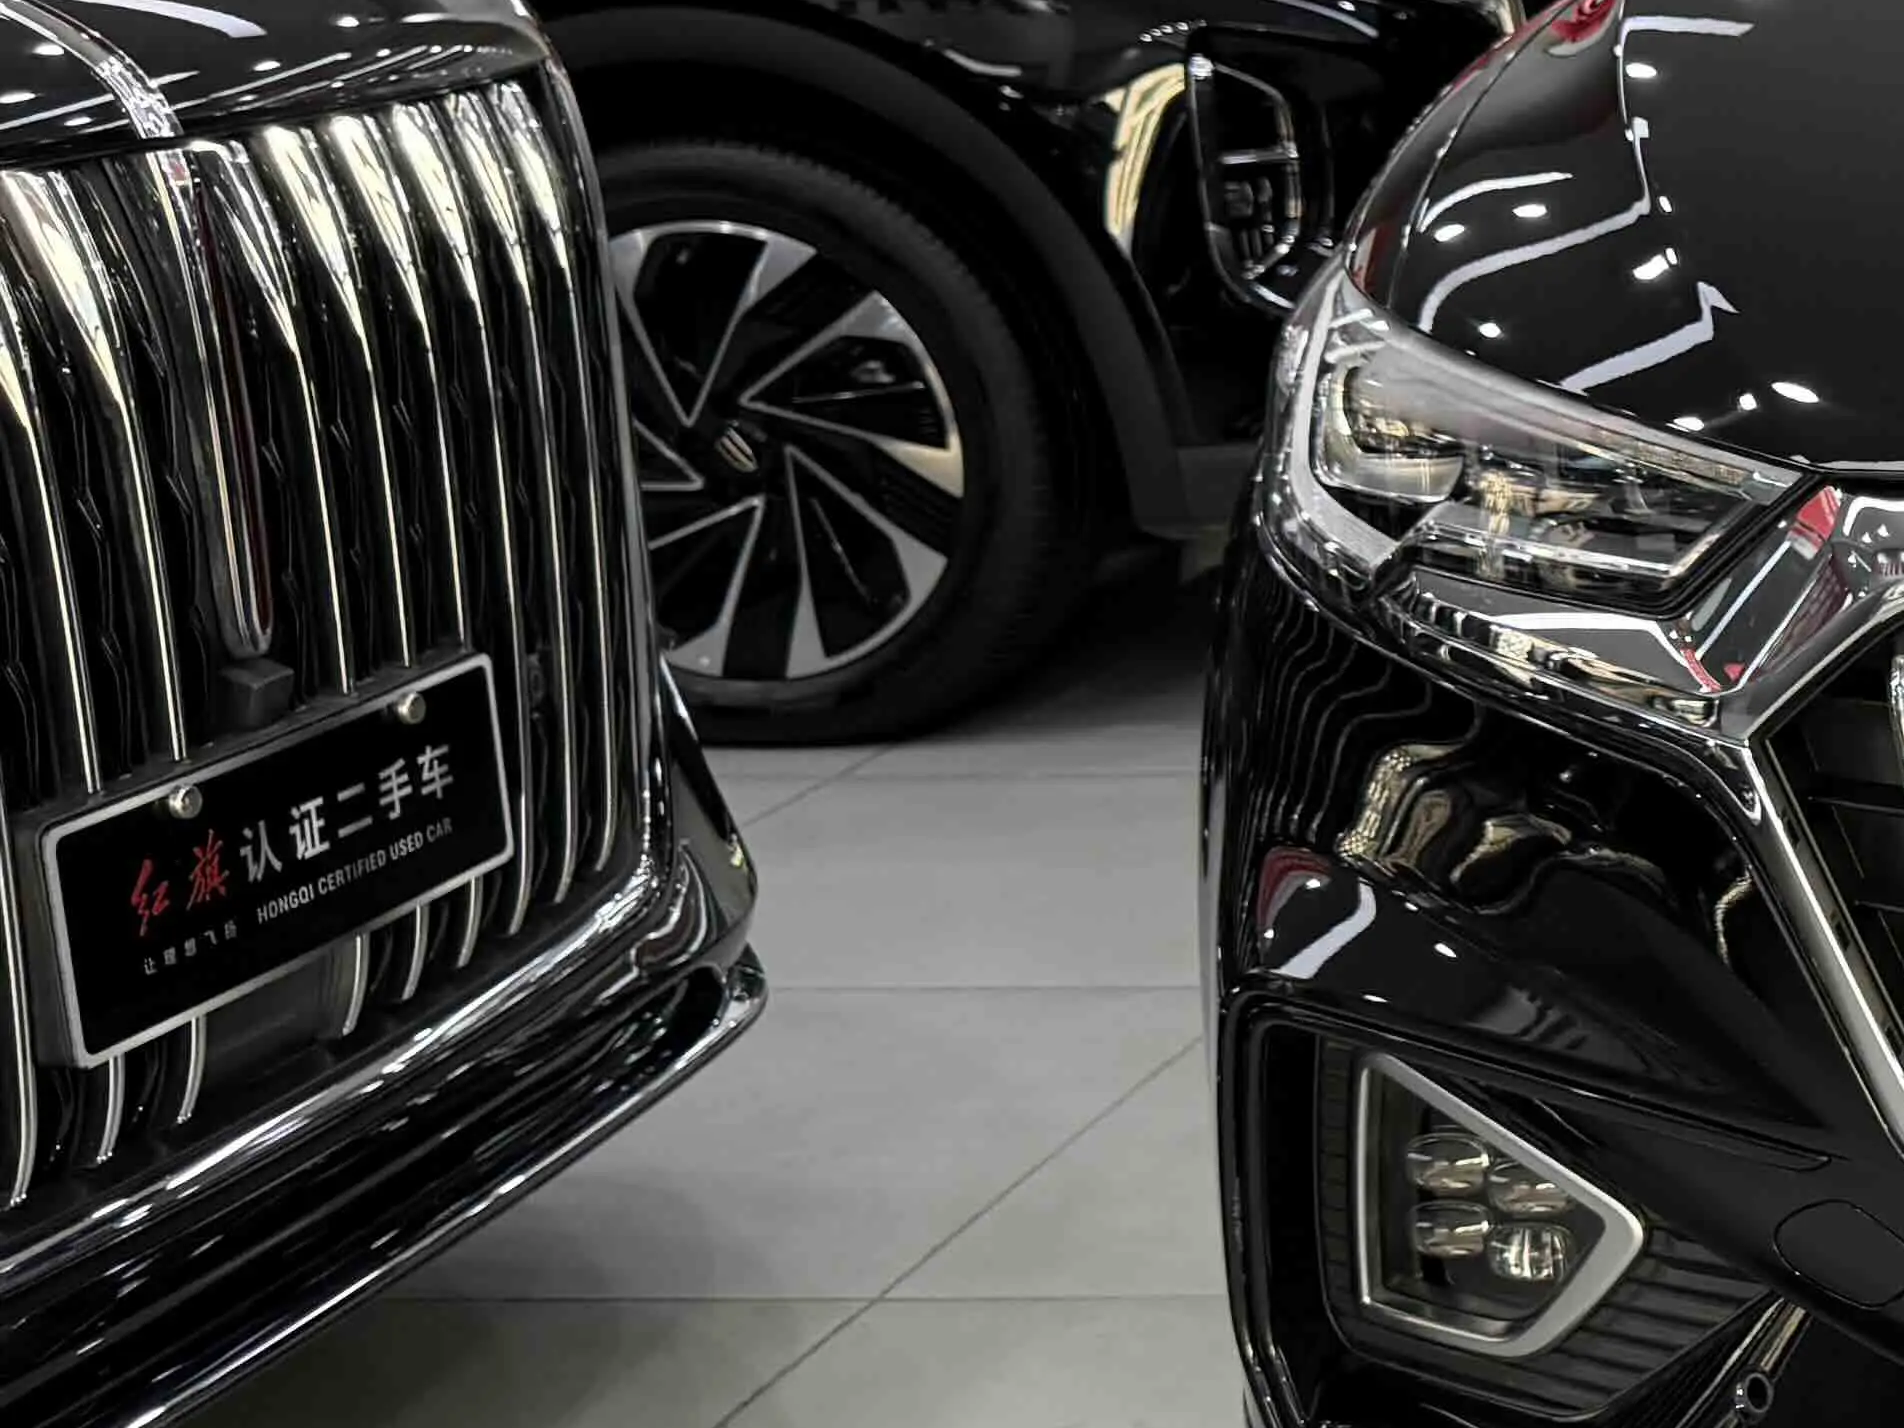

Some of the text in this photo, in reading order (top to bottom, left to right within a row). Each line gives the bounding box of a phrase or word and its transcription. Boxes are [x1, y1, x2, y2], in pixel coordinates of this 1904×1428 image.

[256, 883, 315, 924] HONGQI
[318, 849, 387, 895] CERTIFIED
[389, 830, 424, 861] USED
[426, 817, 453, 843] CAR
